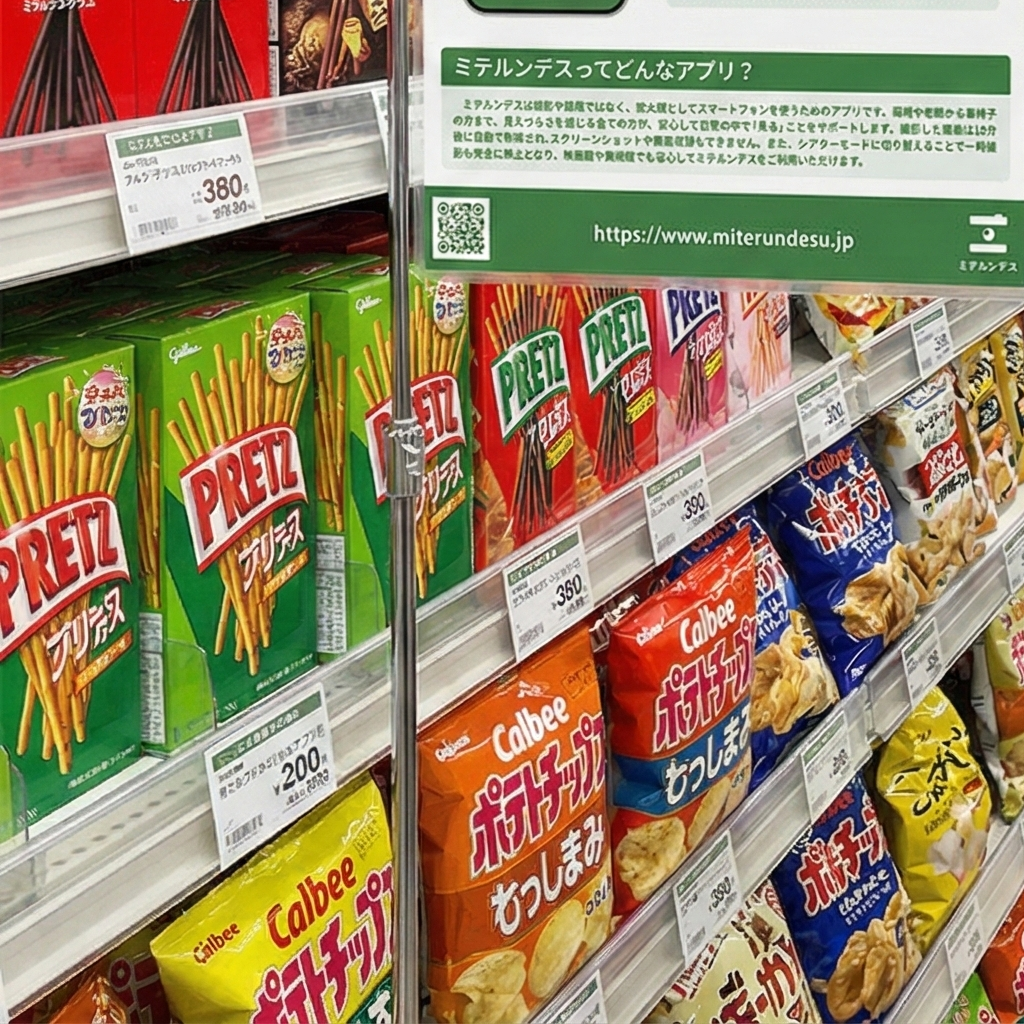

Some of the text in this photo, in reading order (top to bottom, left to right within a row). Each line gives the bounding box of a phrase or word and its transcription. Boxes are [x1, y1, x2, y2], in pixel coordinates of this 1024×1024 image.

[593, 224, 855, 253] https://www.miterundesu.jp
[497, 334, 565, 427] PRETZ
[189, 429, 299, 551] PRETZ
[680, 598, 737, 654] Calbee
[492, 696, 570, 763] Calbee
[279, 856, 358, 950] Calbee
